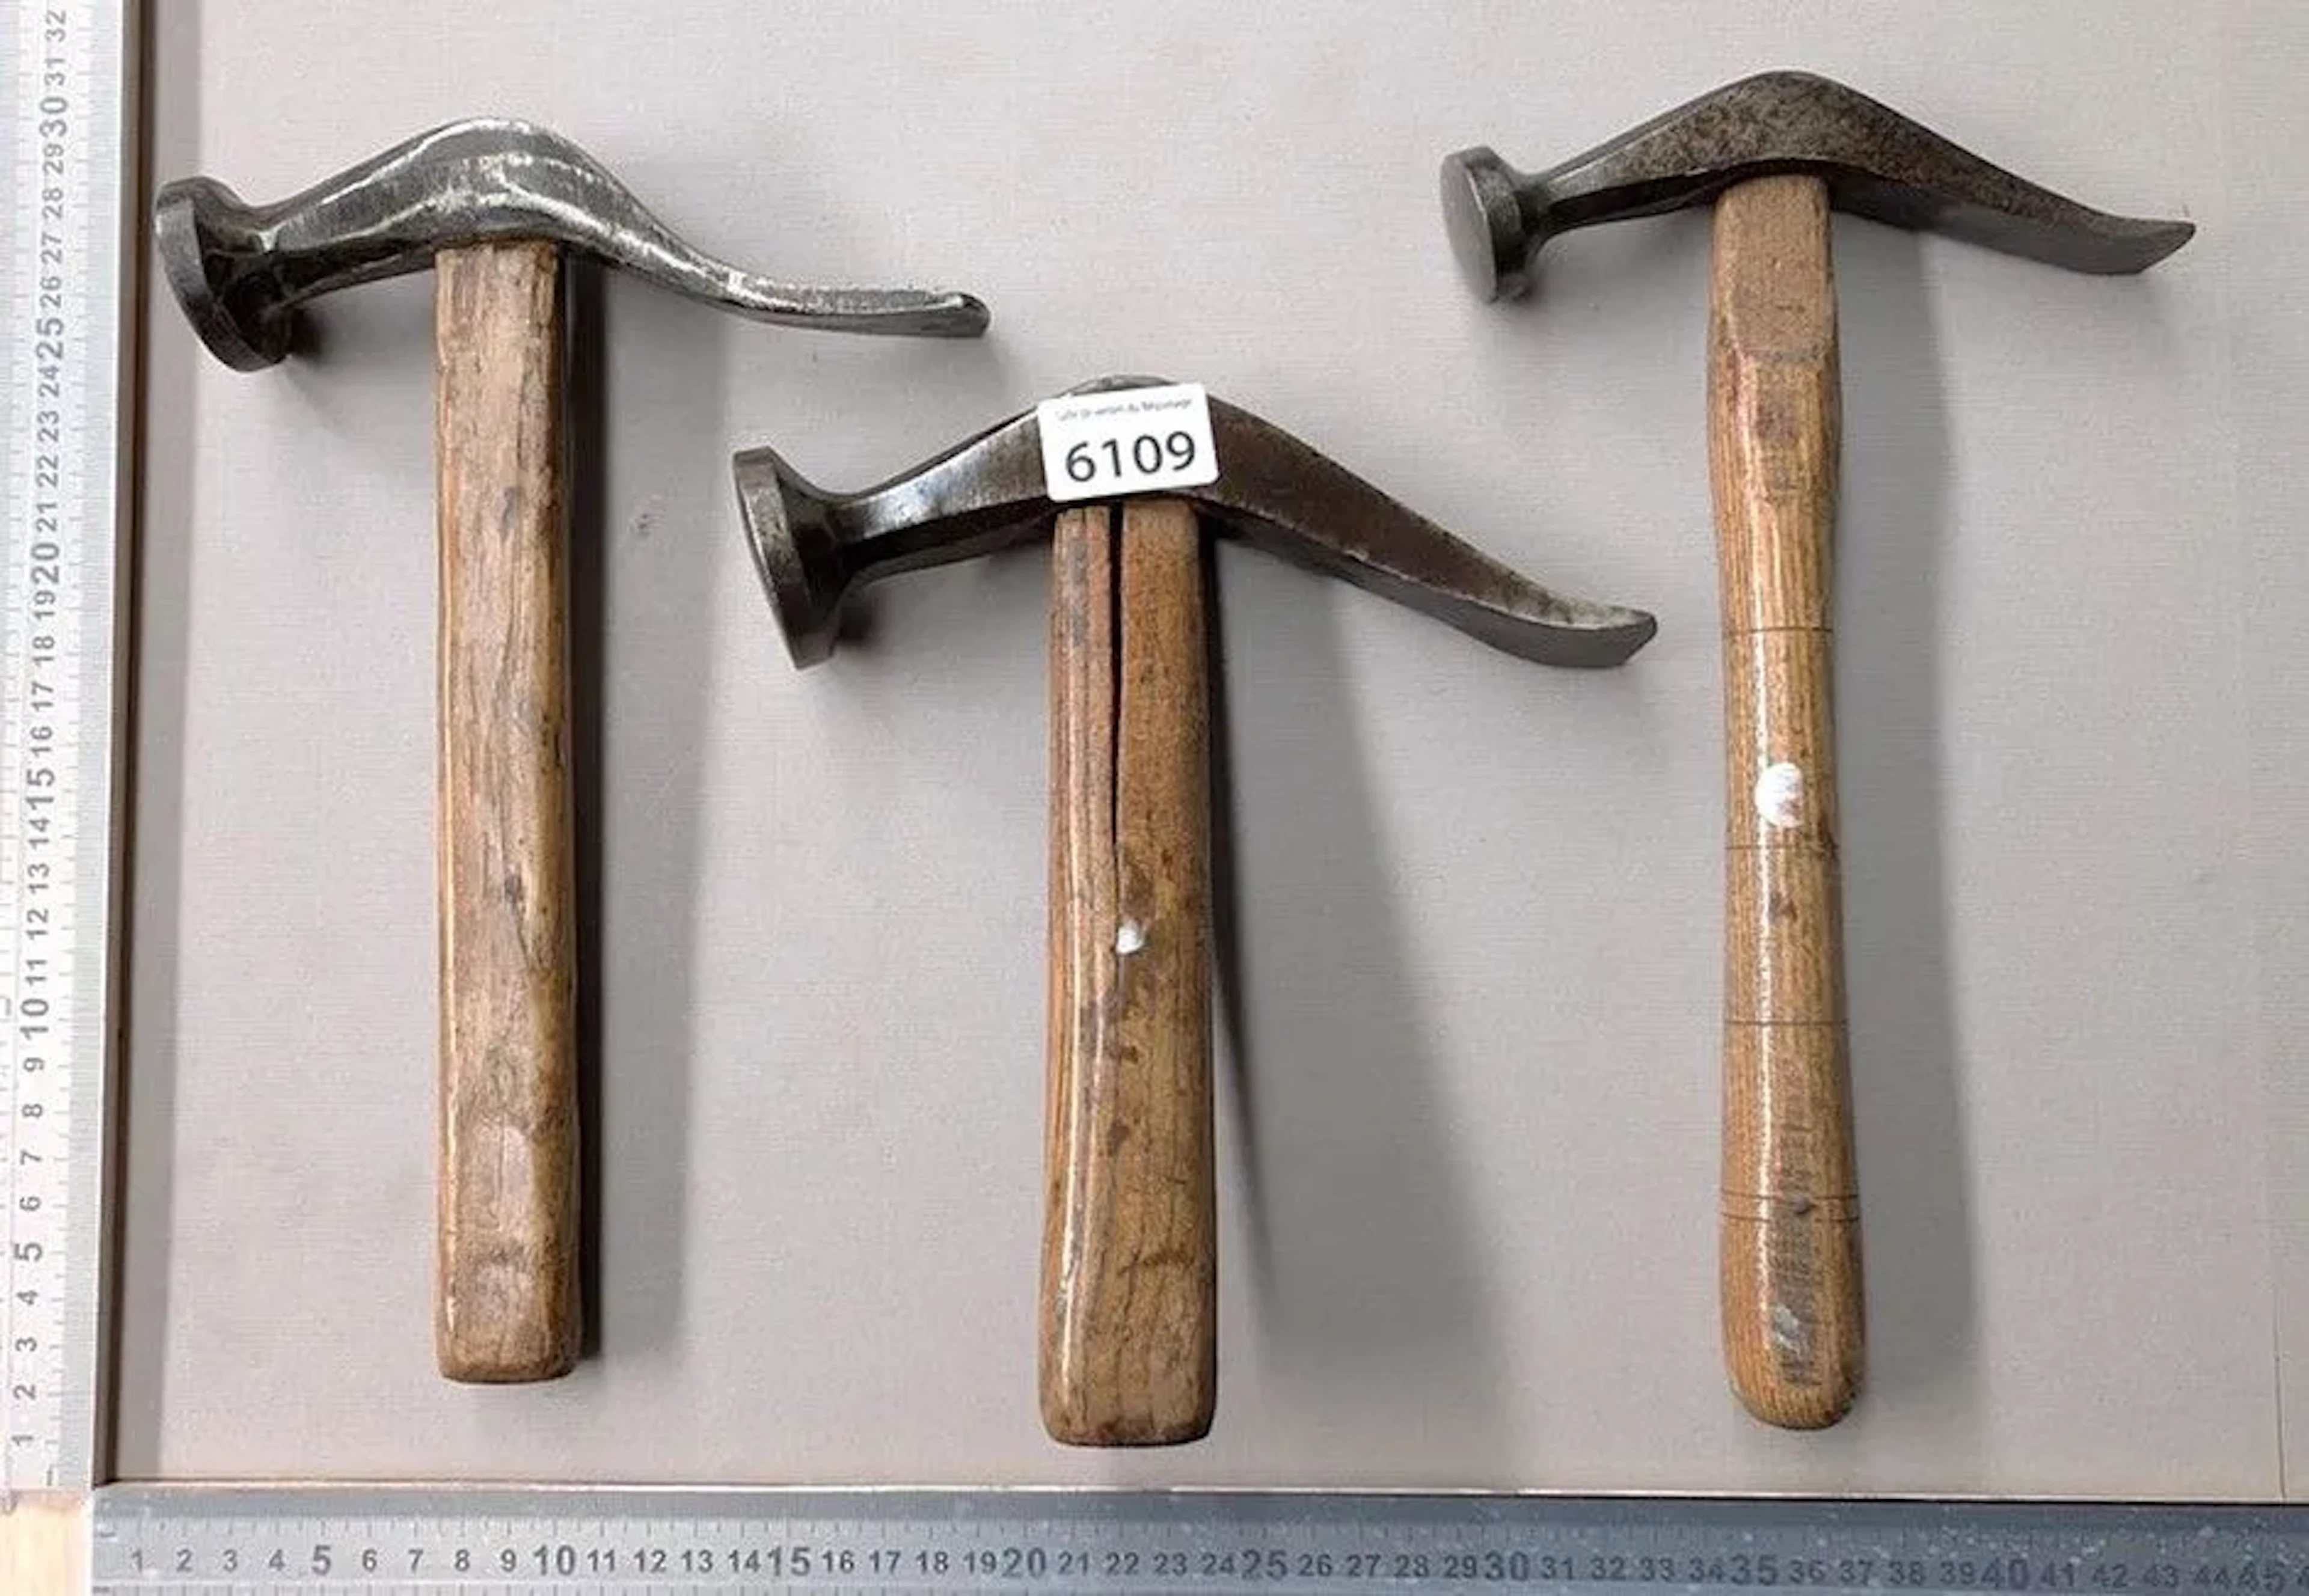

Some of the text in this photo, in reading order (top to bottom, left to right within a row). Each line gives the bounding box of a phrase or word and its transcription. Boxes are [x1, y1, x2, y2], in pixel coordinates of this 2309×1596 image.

[1065, 431, 1195, 482] 6109
[11, 10, 67, 1446] 1 2 3 4 5 6 7 8 9 10 11 12 13 14 15 16 17 18 19 20 21 22 23 24 25 26 27 28 29 30 31 32
[130, 1550, 144, 1573] 1
[176, 1550, 192, 1573] 2
[223, 1550, 238, 1573] 3
[269, 1550, 284, 1573] 4
[312, 1544, 333, 1576] 5
[362, 1550, 378, 1573] 6
[408, 1550, 425, 1573] 7
[455, 1550, 470, 1573] 8
[500, 1550, 517, 1573] 9
[533, 1544, 575, 1576] 10
[588, 1550, 616, 1573] 11
[634, 1550, 666, 1573] 12
[681, 1551, 713, 1573] 13
[728, 1551, 761, 1573] 14
[768, 1545, 811, 1576] 15
[822, 1551, 854, 1573] 16
[869, 1552, 901, 1574] 17
[916, 1552, 949, 1574] 18
[964, 1552, 996, 1574] 19
[1002, 1546, 1046, 1577] 20
[1058, 1552, 1088, 1575] 21
[1106, 1553, 1139, 1576] 22
[1153, 1553, 1188, 1576] 23
[1203, 1553, 1235, 1576] 24
[1242, 1548, 1287, 1580] 25
[1299, 1555, 1332, 1577] 26
[1346, 1555, 1381, 1578] 27
[1394, 1555, 1429, 1578] 28
[1444, 1556, 1477, 1579] 29
[1484, 1550, 1530, 1582] 30
[1541, 1557, 1574, 1580] 31
[1591, 1558, 1626, 1580] 32
[1640, 1558, 1675, 1581] 33
[1688, 1559, 1723, 1582] 34
[1731, 1554, 1779, 1586] 35
